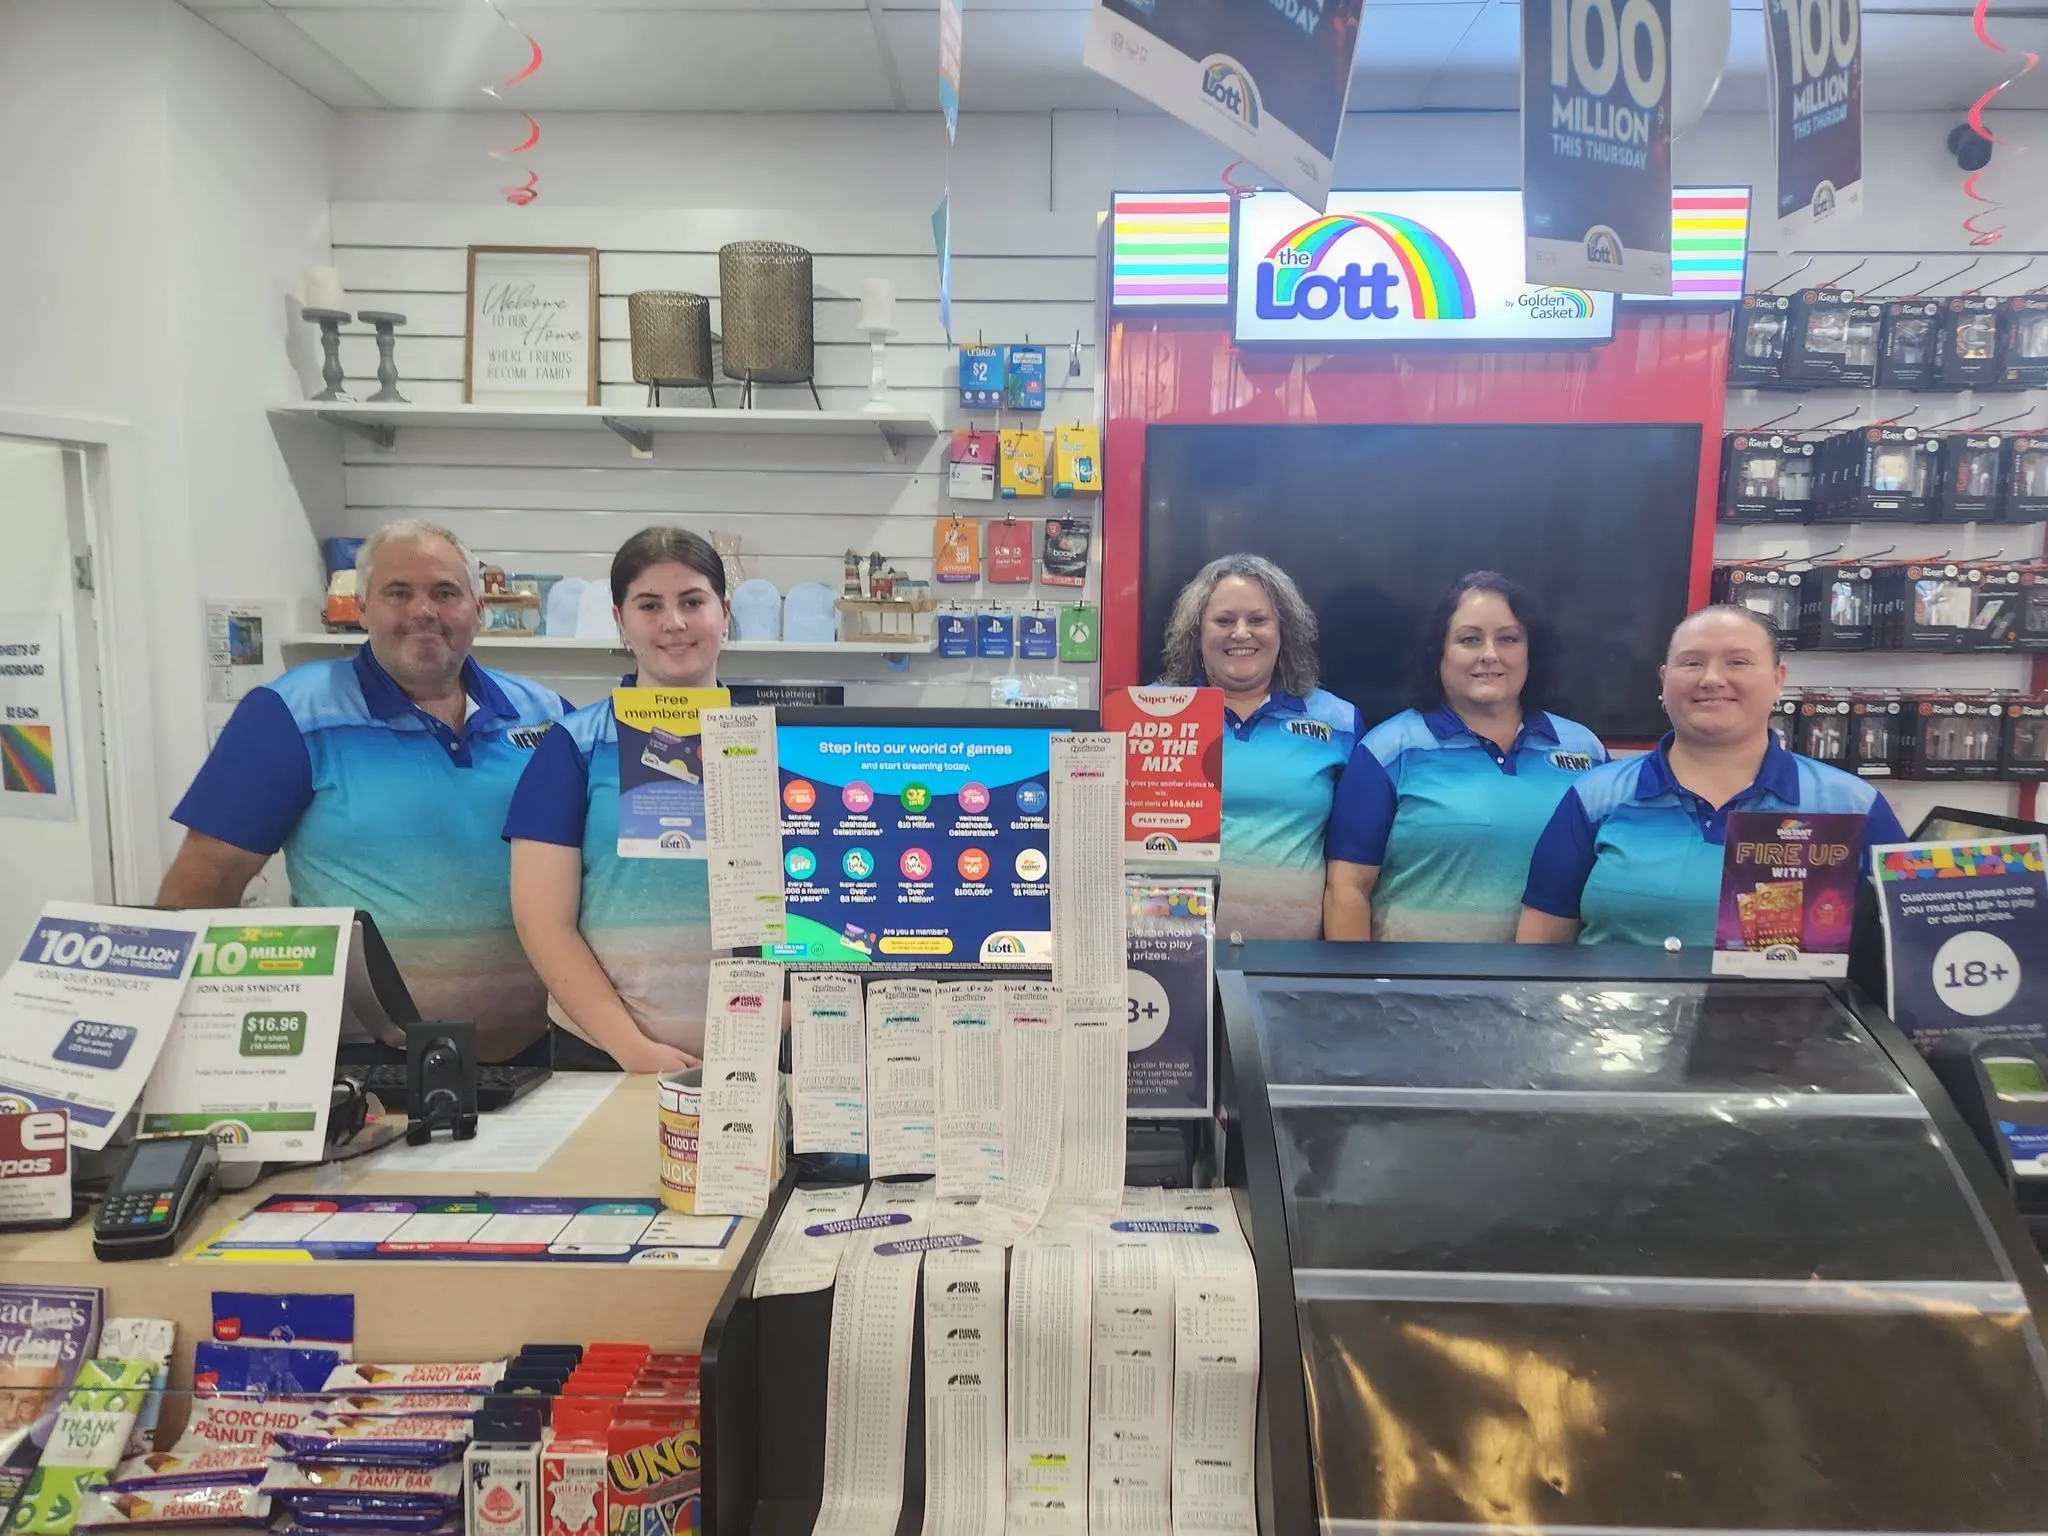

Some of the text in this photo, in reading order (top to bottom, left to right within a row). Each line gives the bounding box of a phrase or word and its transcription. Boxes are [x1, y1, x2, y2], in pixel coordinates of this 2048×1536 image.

[1203, 70, 1243, 115] Lott
[1793, 70, 1848, 120] MILLION
[1552, 97, 1649, 146] MILLION
[1793, 103, 1848, 141] THIS THURSDAY
[1552, 134, 1647, 171] THIS THURSDAY
[1278, 247, 1310, 266] the
[1257, 262, 1399, 320] Lott
[1818, 292, 1840, 303] iGear
[482, 282, 569, 316] Welcome
[1504, 300, 1515, 309] by
[1518, 293, 1566, 309] Golden
[1756, 298, 1776, 308] iGear
[1530, 305, 1574, 319] Casket
[492, 315, 528, 328] TO OUR
[520, 312, 582, 346] Home
[488, 350, 573, 363] WHERE FRIENDS
[487, 366, 572, 380] BECOME FAMILY
[973, 362, 988, 381] $2
[1882, 430, 1904, 441] iGear
[1749, 438, 1770, 448] iGear
[1745, 572, 1767, 583] iGear
[1922, 567, 1945, 577] iGear
[655, 694, 688, 705] Free
[757, 689, 816, 699] Lucky Lotteries
[1138, 694, 1169, 706] Super
[16, 706, 39, 718] EACH
[1128, 722, 1200, 738] ADD IT
[1292, 722, 1328, 742] NEWS
[819, 741, 1012, 757] Step into our world of games
[1129, 740, 1198, 756] TO THE
[862, 762, 971, 772] and start dreaming today.
[1142, 756, 1184, 773] MIX
[1160, 780, 1184, 788] another
[1185, 780, 1206, 788] chance
[897, 821, 934, 829] $10 Million
[1011, 821, 1028, 830] $100
[796, 828, 819, 836] Million
[1776, 828, 1813, 836] INSTANT
[1145, 841, 1167, 852] Lott
[1736, 842, 1849, 867] FIRE UP
[1772, 867, 1808, 878] WITH
[907, 888, 925, 896] Over
[1900, 886, 2035, 902] Customers please note
[1902, 899, 2035, 916] you must be 18+ to play
[1928, 911, 2015, 924] or claim prizes.
[896, 928, 909, 937] you
[916, 928, 949, 936] member?
[1128, 928, 1192, 938] please note
[40, 929, 180, 969] $100 MILLION
[249, 945, 316, 959] MILLION
[1135, 940, 1192, 951] 18+ to play
[1134, 950, 1170, 962] prizes.
[109, 957, 174, 971] THIS THURSDAY
[35, 969, 60, 981] JOIN
[63, 973, 88, 984] OUR
[89, 975, 152, 991] SYNDICATE
[1944, 961, 2008, 988] 18+
[197, 983, 301, 994] JOIN OUR SYNDICATE
[247, 1017, 299, 1032] $16.96
[92, 1039, 113, 1048] share
[263, 1042, 290, 1051] shares)
[1174, 1062, 1190, 1070] age
[1148, 1070, 1192, 1078] participate
[823, 1215, 891, 1230] SUPERDRAW
[829, 1220, 891, 1233] SYNDICATE
[893, 1235, 963, 1250] SUPERDRAW
[899, 1240, 963, 1253] SYNDICATE
[218, 1325, 237, 1335] NEW
[402, 1372, 481, 1383] PEANUT BAR
[61, 1417, 120, 1433] THANK
[207, 1408, 299, 1429] SCORCHED
[193, 1421, 257, 1444] PEANUT
[68, 1432, 103, 1447] YOU
[609, 1432, 701, 1493] UNO
[349, 1475, 432, 1488] PEANUT BAR
[163, 1501, 244, 1518] PEANUT BAR
